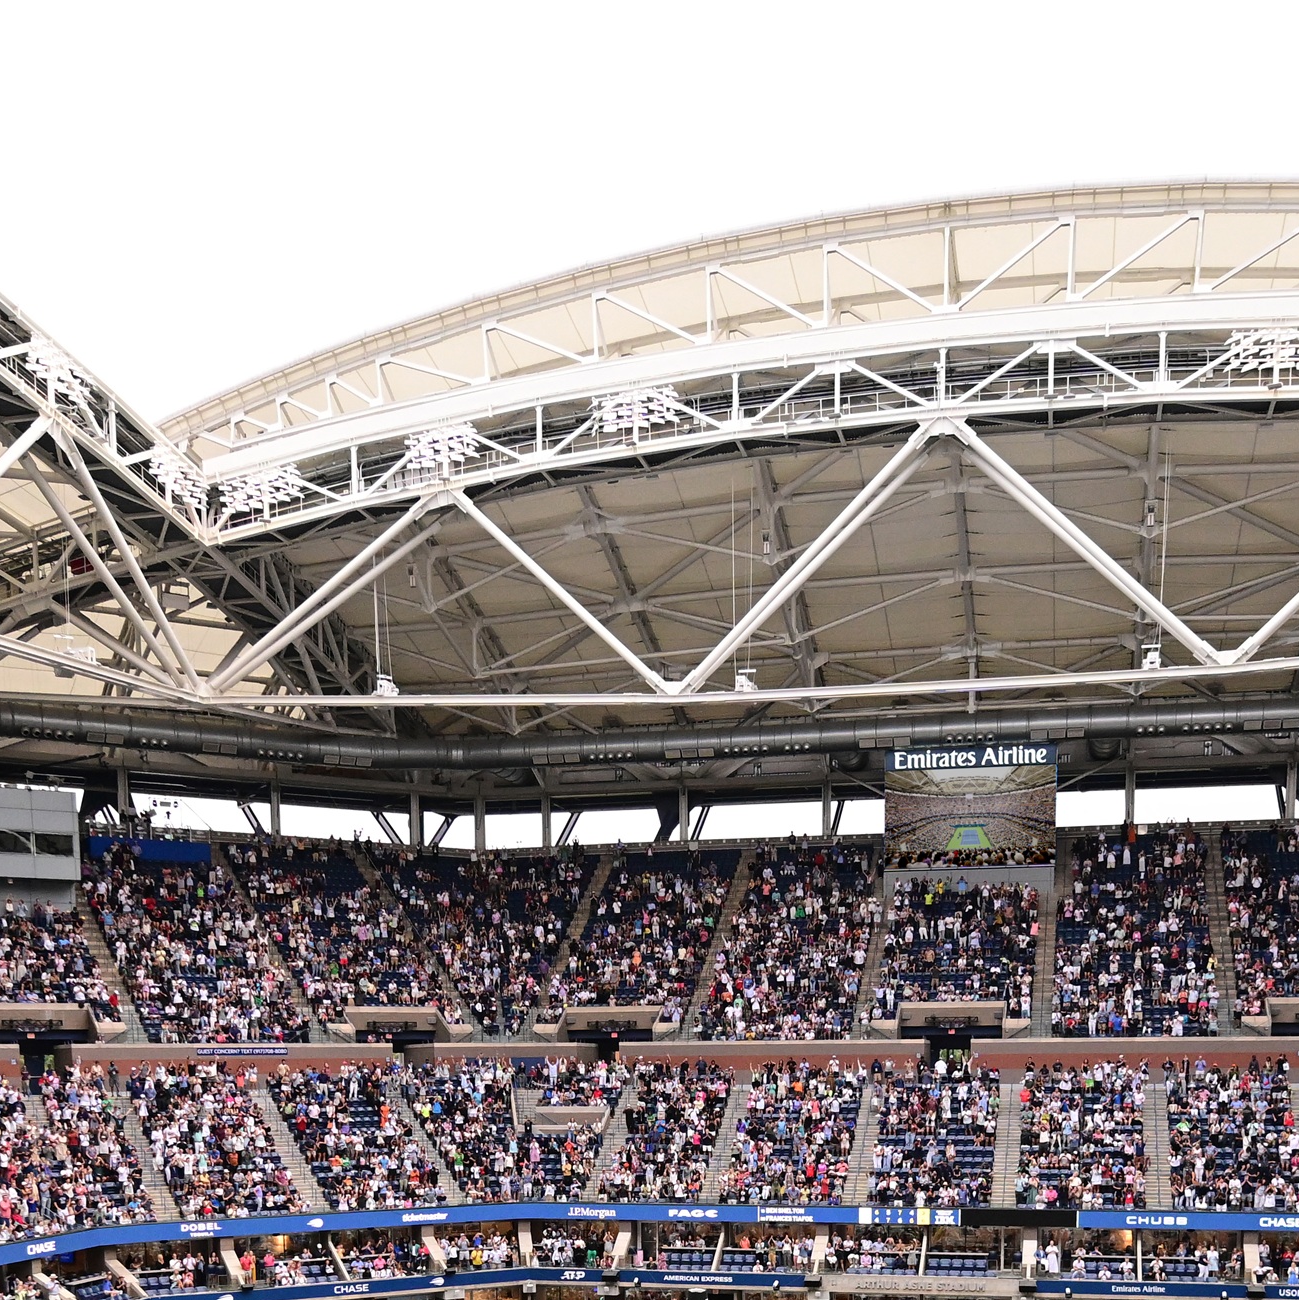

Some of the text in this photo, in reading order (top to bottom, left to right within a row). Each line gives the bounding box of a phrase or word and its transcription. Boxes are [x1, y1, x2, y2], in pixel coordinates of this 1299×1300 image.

[894, 745, 1047, 770] Emirates Airline
[402, 1212, 448, 1223] ticketmaster
[567, 1207, 617, 1219] J.P.Morgan
[1126, 1215, 1188, 1226] CHUBB
[180, 1222, 222, 1233] DOBEL
[27, 1240, 56, 1255] CHASE
[560, 1270, 585, 1280] ATP
[663, 1274, 733, 1283] AMERICAN EXPRESS
[333, 1283, 370, 1294] CHASE
[855, 1280, 986, 1292] ARTHUR ASHE STADIUM
[1111, 1285, 1166, 1293] Emirates Airline
